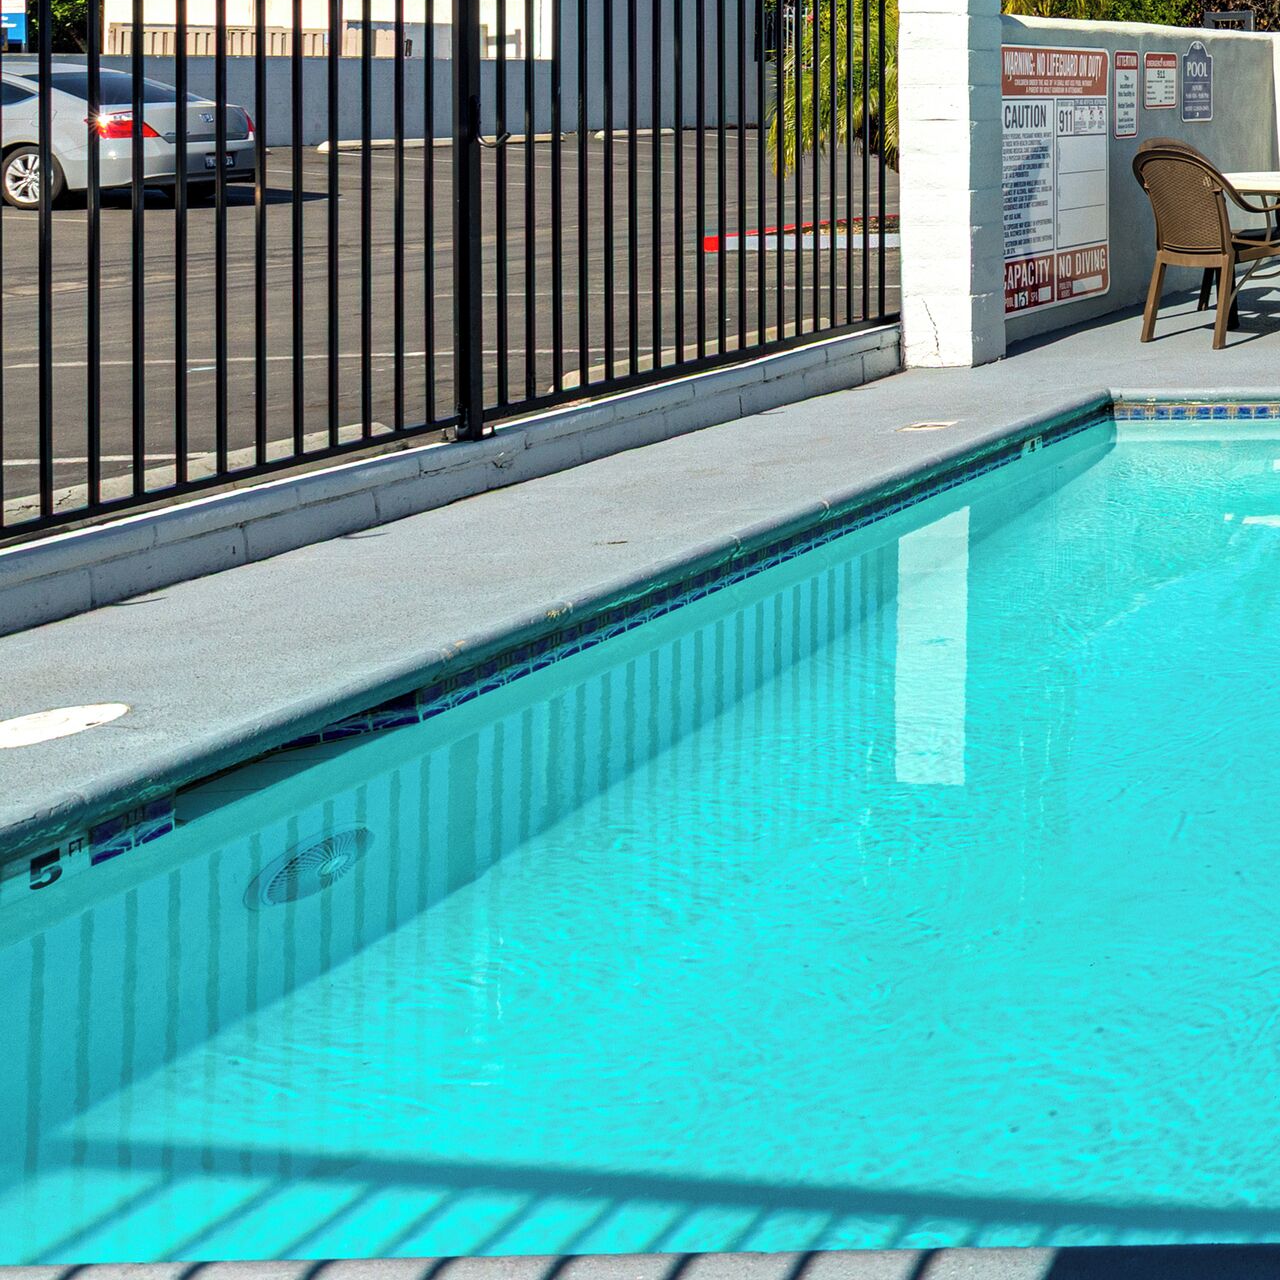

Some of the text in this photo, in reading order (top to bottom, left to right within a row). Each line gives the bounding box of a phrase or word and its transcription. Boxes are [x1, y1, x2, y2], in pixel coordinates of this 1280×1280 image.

[1004, 51, 1103, 79] WARNING: NO LIFEGUARD ON DUTY
[1186, 61, 1208, 77] POOL
[1004, 104, 1047, 129] CAUTION
[1059, 109, 1073, 133] 911
[1059, 248, 1106, 279] NO DIVING
[29, 836, 85, 890] 5 FT
